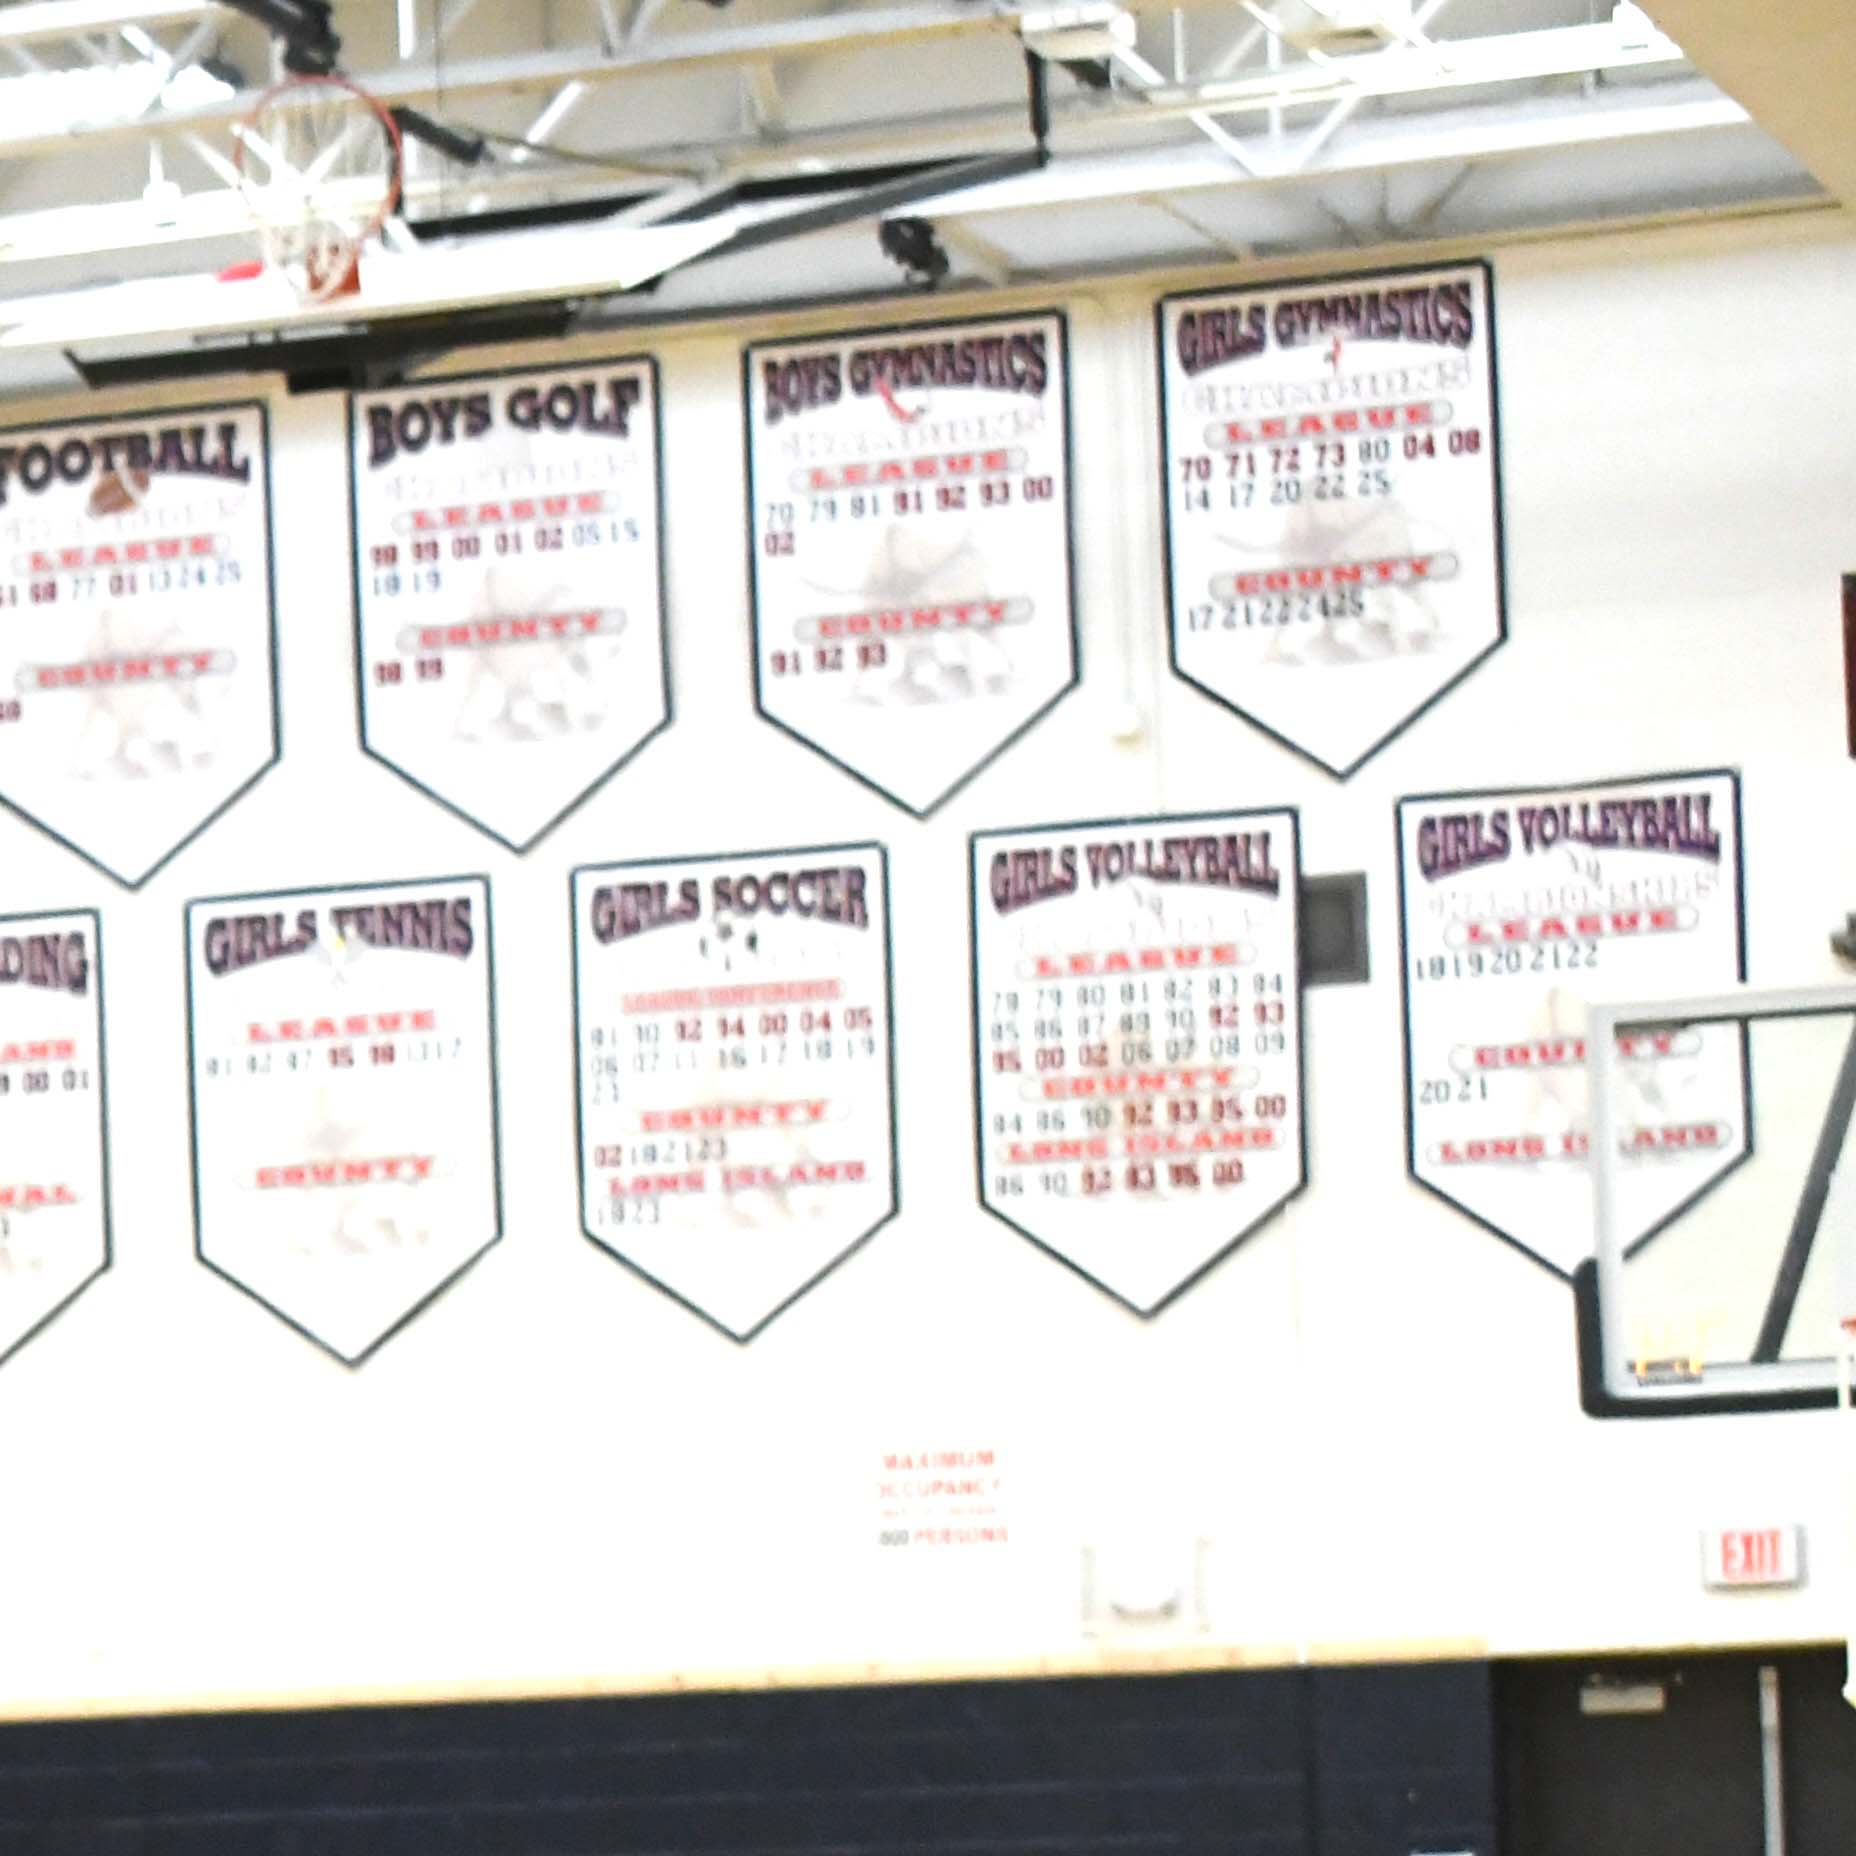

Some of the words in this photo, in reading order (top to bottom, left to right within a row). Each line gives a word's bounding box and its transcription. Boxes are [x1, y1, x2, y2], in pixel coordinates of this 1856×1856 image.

[1176, 303, 1266, 378] GIRLS
[1273, 282, 1472, 349] GYMNASTICS
[368, 392, 492, 469] BOYS
[505, 378, 639, 439] GOLF
[1225, 403, 1433, 443] LEAGUE
[811, 451, 1006, 488] LEAGUE
[1225, 453, 1255, 478] 71
[1269, 449, 1300, 475] 72
[1313, 444, 1346, 468] 73
[1403, 434, 1435, 458] 04
[1269, 479, 1301, 504] 20
[412, 494, 603, 530] LEAGUE
[30, 535, 213, 573] LEAGUE
[1235, 559, 1431, 595] COUNTY
[419, 609, 602, 649] COUNTY
[818, 603, 1005, 639] COUNTY
[37, 651, 213, 687] COUNTY
[1417, 809, 1511, 882] GIRLS
[1517, 793, 1720, 863] VOLLEYBALL
[991, 846, 1076, 916] GIRLS
[1085, 832, 1281, 899] VOLLEYBALL
[591, 878, 700, 946] GIRLS
[712, 866, 869, 931] SOCCER
[205, 909, 316, 977] GIRLS
[329, 897, 473, 961] TENNIS
[1467, 908, 1677, 943] LEAGUE
[1036, 945, 1237, 977] LEAGUE
[1491, 949, 1521, 974] 20
[1530, 946, 1560, 970] 21
[1567, 943, 1597, 967] 22
[248, 1010, 435, 1043] LEAGUE
[1474, 1029, 1677, 1068] COUTY
[1042, 1069, 1234, 1099] COUNTY
[1419, 1080, 1450, 1104] 20
[1458, 1076, 1486, 1101] 21
[641, 1099, 826, 1131] COUNTY
[1009, 1138, 1108, 1166] LONG
[1125, 1128, 1274, 1157] ISLAND
[1440, 1137, 1544, 1162] LONG
[1563, 1124, 1718, 1155] ISAND
[256, 1156, 433, 1188] COUNTY
[610, 1171, 703, 1199] LONG
[722, 1161, 866, 1191] ISLAND
[1721, 1528, 1782, 1580] EXIT
